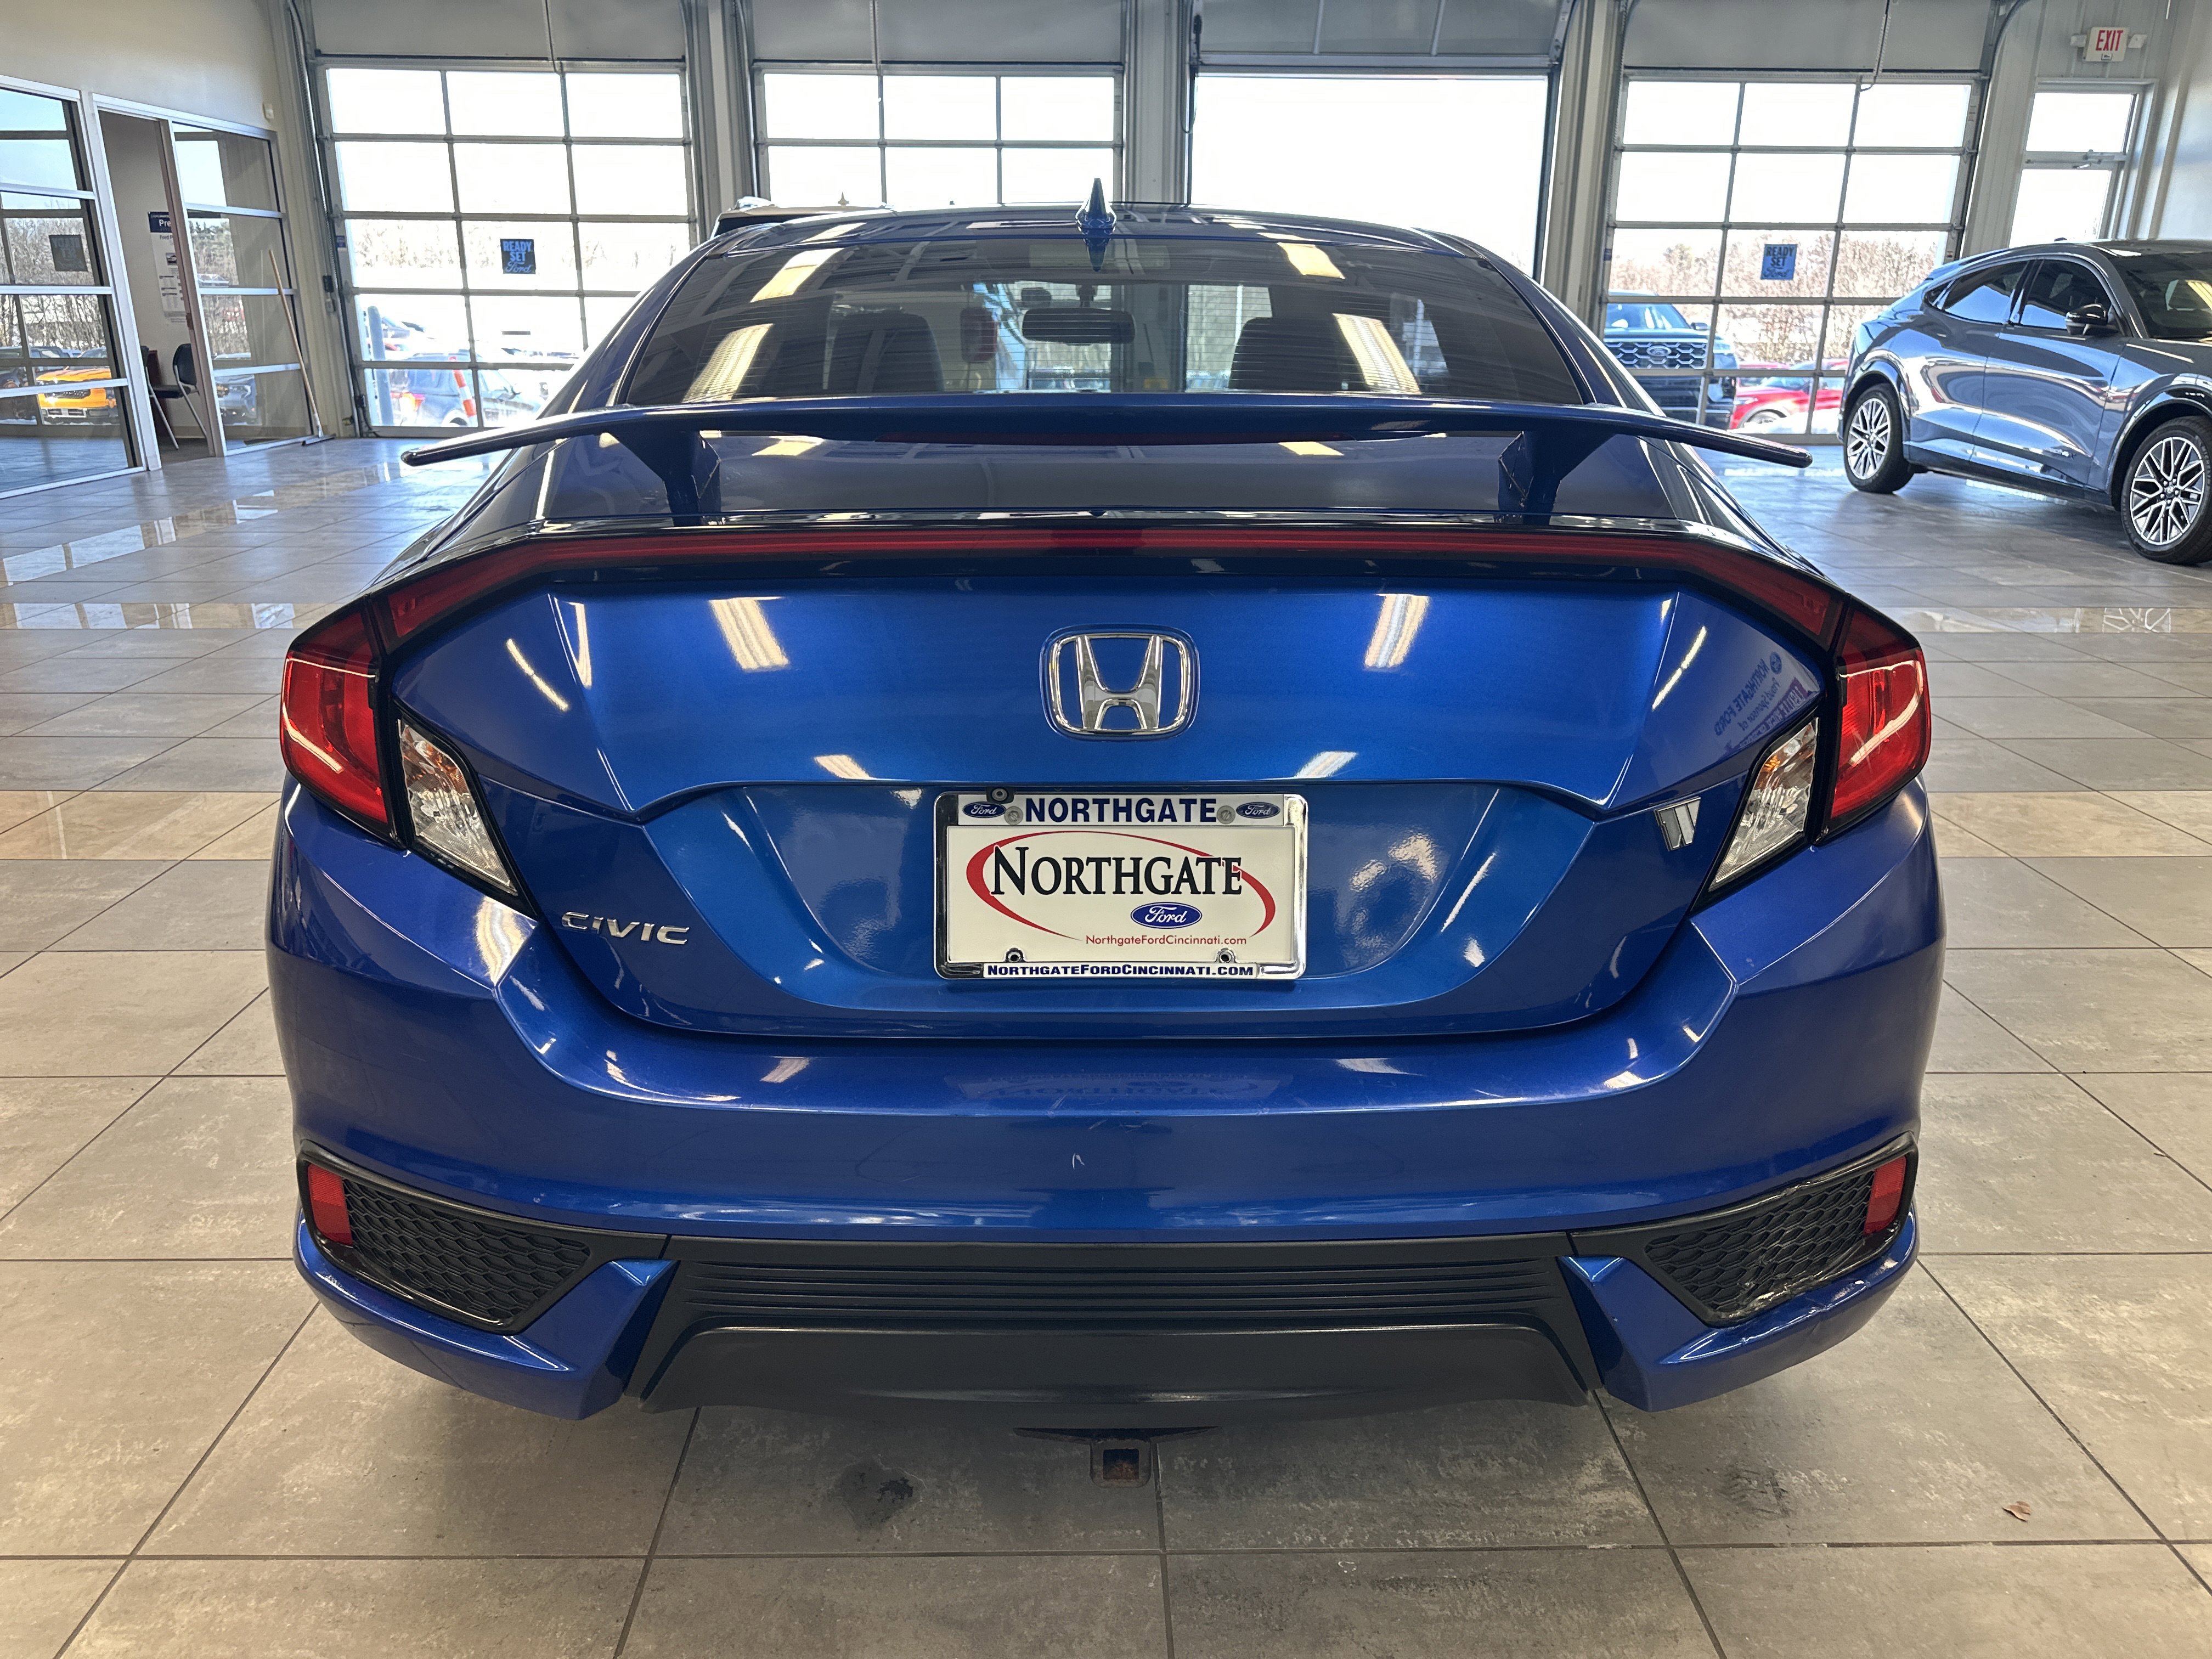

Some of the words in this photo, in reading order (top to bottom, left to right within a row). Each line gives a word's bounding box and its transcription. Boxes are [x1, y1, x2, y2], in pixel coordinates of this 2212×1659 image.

[2096, 30, 2124, 51] EXIT
[503, 240, 532, 252] READY
[1766, 246, 1795, 257] READY
[510, 252, 526, 262] SET
[1770, 257, 1787, 267] SET
[505, 261, 532, 273] Ford
[970, 804, 997, 815] Ford
[1025, 798, 1217, 822] NORTHGATE
[1244, 804, 1271, 815] Ford
[991, 847, 1242, 895] NORTHGATE
[1144, 906, 1188, 923] Ford
[561, 911, 690, 945] CIVIC
[1086, 934, 1246, 946] NorthgateFordCincinnati.com
[988, 963, 1254, 976] NORTHGATEFORDCINCINNATI.COM
